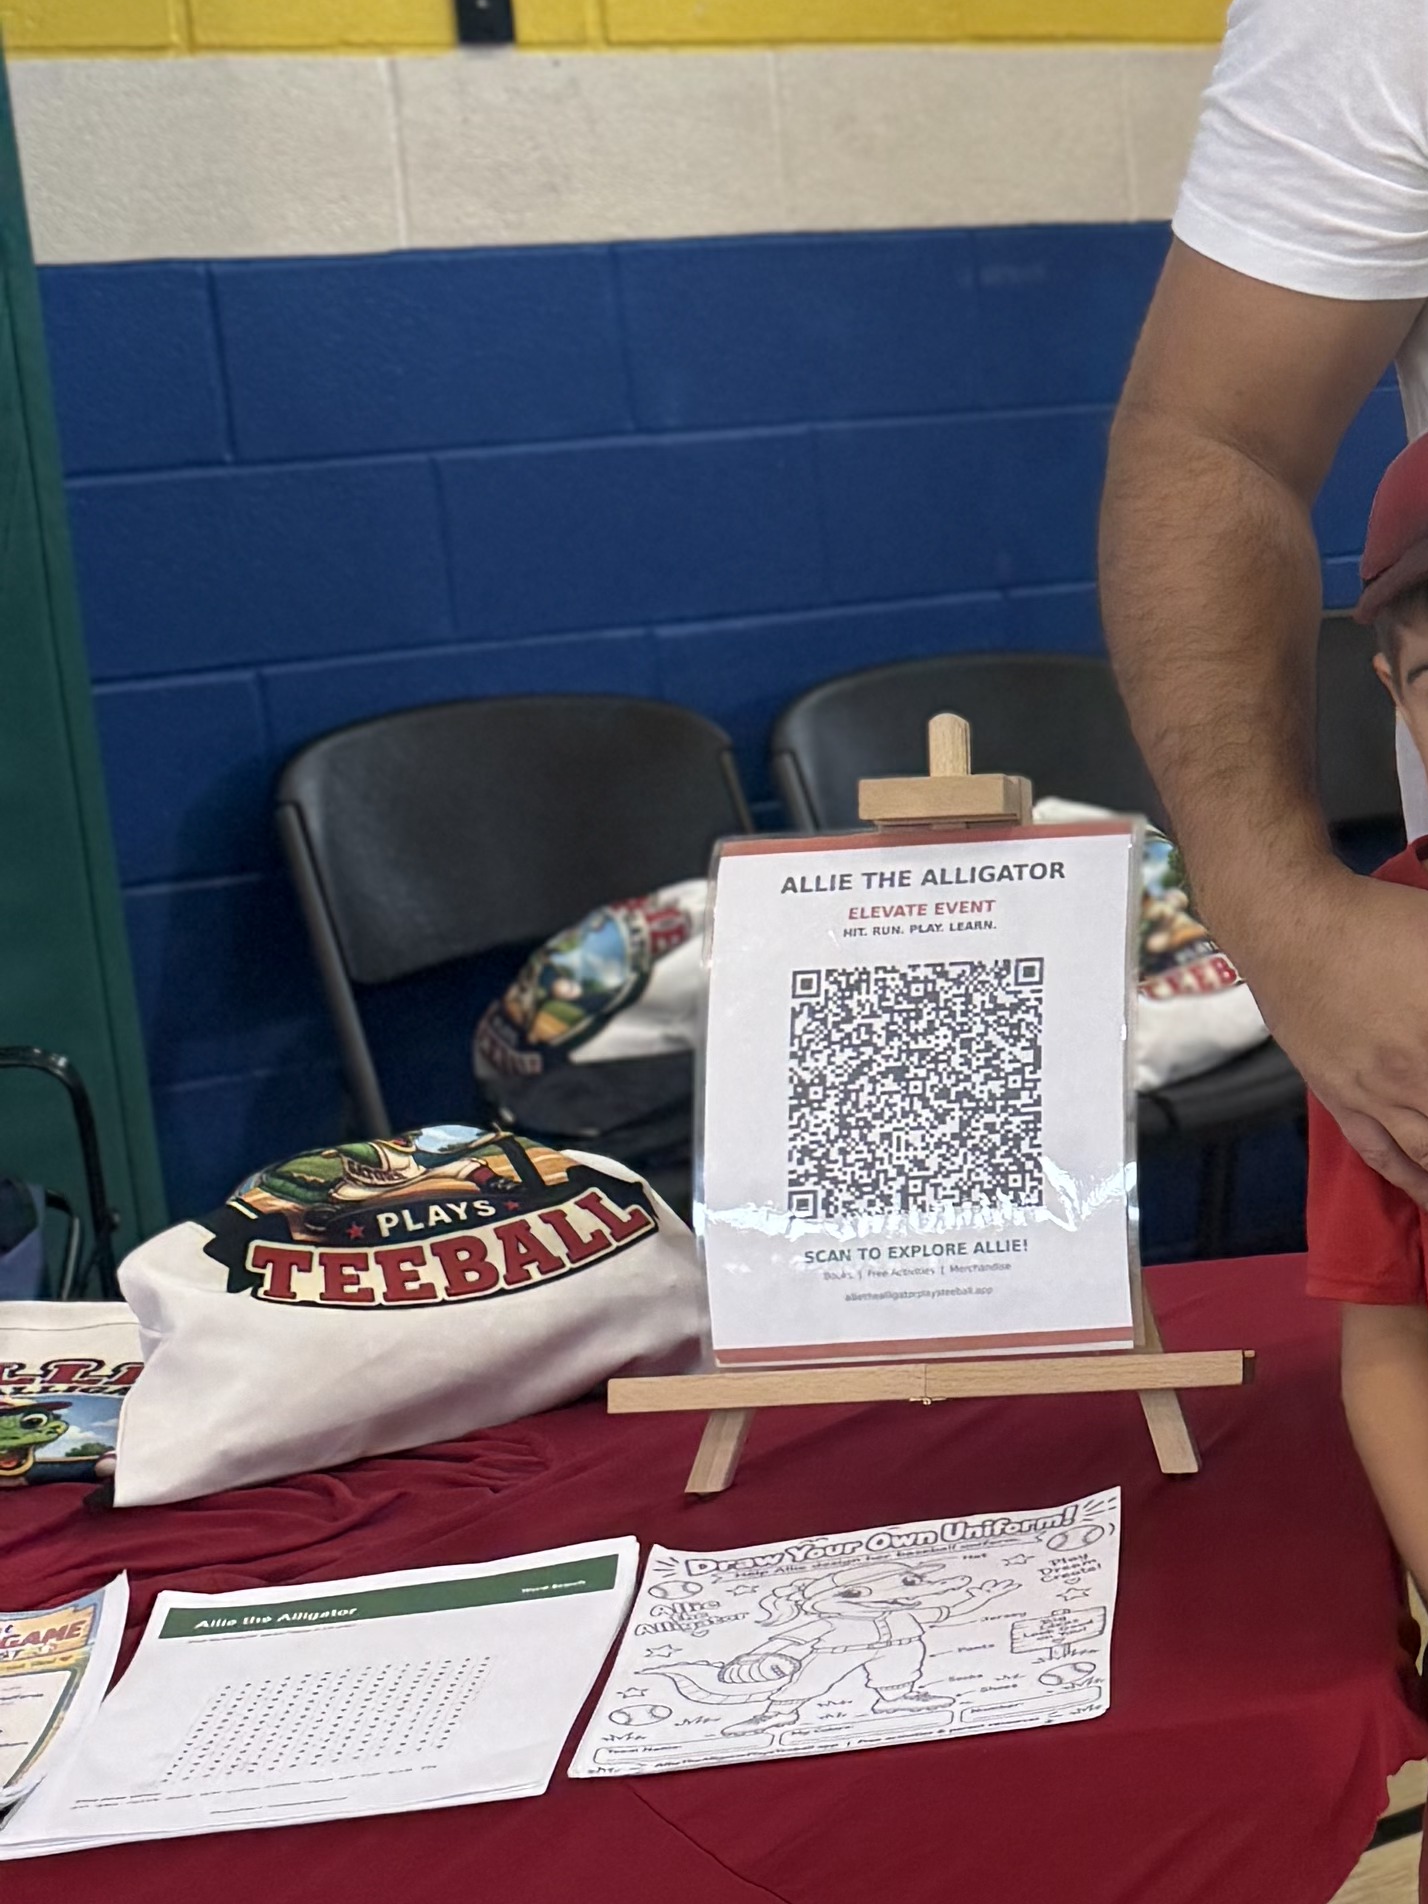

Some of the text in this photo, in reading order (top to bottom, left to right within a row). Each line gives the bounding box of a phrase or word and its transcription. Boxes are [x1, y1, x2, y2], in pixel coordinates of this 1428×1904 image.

[780, 861, 1066, 894] ALLIE THE ALLIGATOR
[848, 899, 997, 920] ELEVATE EVENT
[843, 920, 997, 938] HIT. RUN. PLAY. LEARN.
[376, 1197, 498, 1238] PLAYS
[248, 1190, 655, 1302] TEEBALL
[804, 1239, 1028, 1264] SCAN TO EXPLORE ALLIE!
[684, 1504, 1079, 1577] Draw Your Own Uniform!
[193, 1607, 358, 1629] Allie the Alligator
